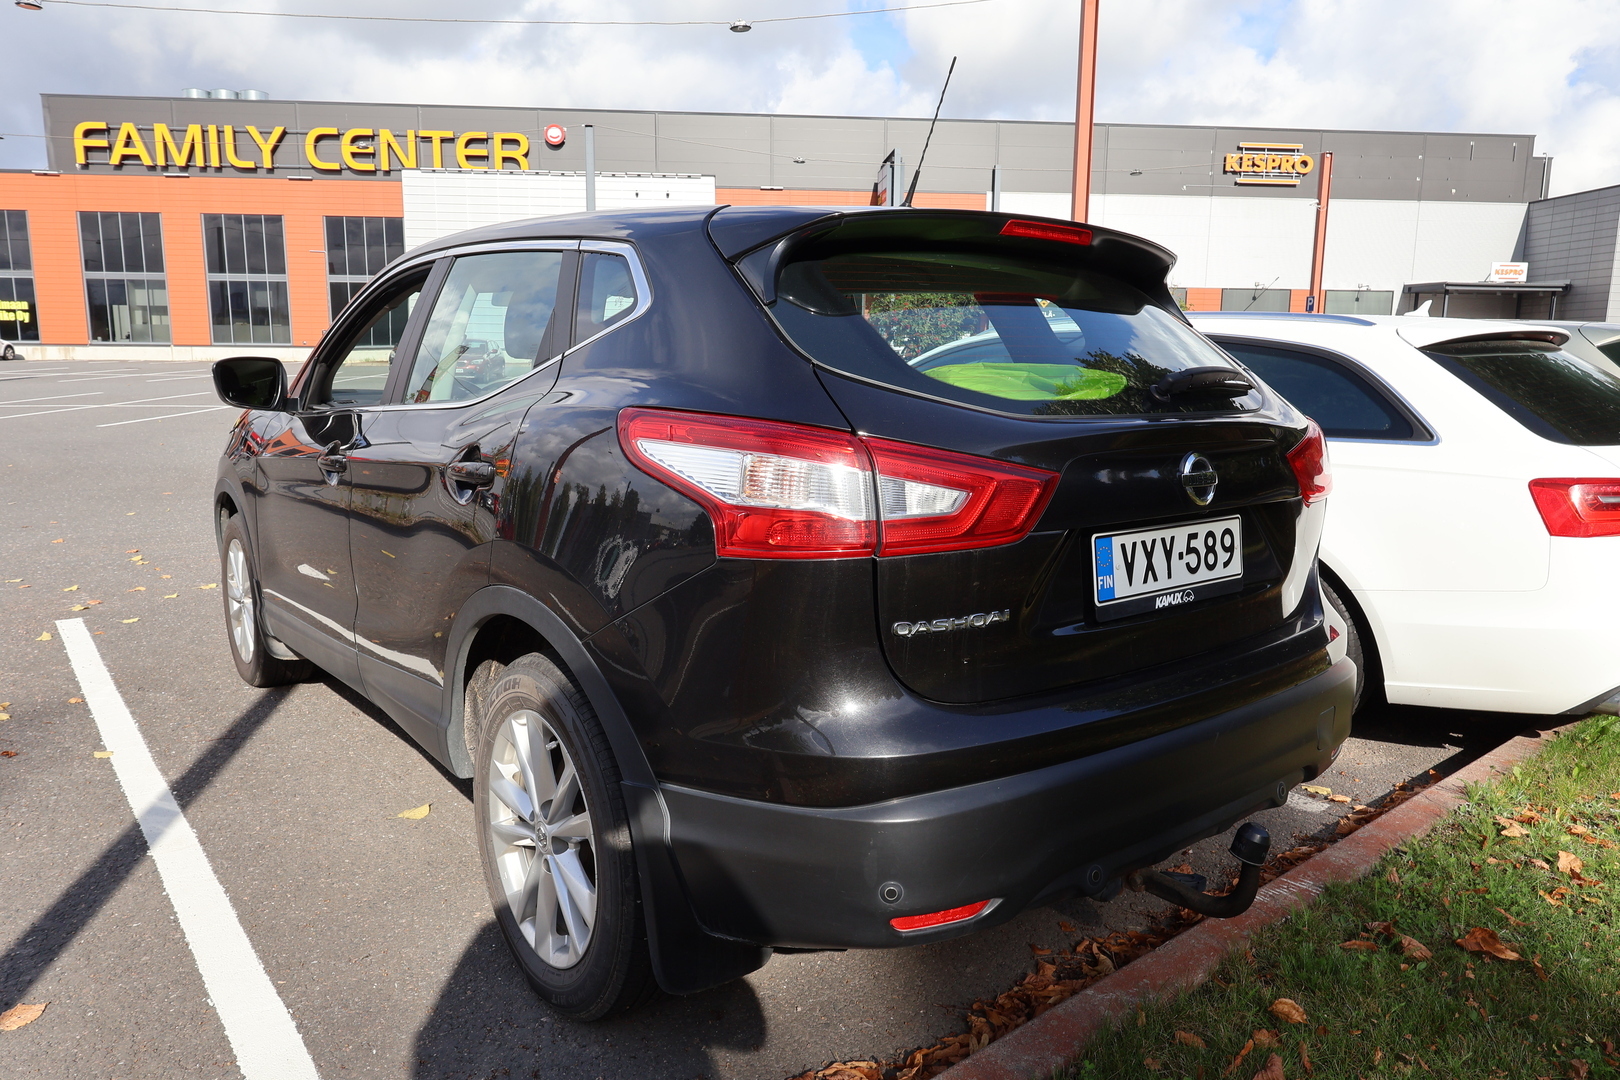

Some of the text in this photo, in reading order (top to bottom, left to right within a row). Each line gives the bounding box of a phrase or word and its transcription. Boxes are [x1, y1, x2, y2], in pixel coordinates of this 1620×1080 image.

[73, 121, 531, 171] FAMILY CENTER
[1225, 153, 1315, 174] KESPRO
[1494, 268, 1525, 276] KESPRO
[1120, 527, 1235, 588] VXY-589
[1098, 574, 1114, 590] FIN
[1155, 592, 1184, 609] KAMUX
[892, 608, 1010, 638] QASHQAI
